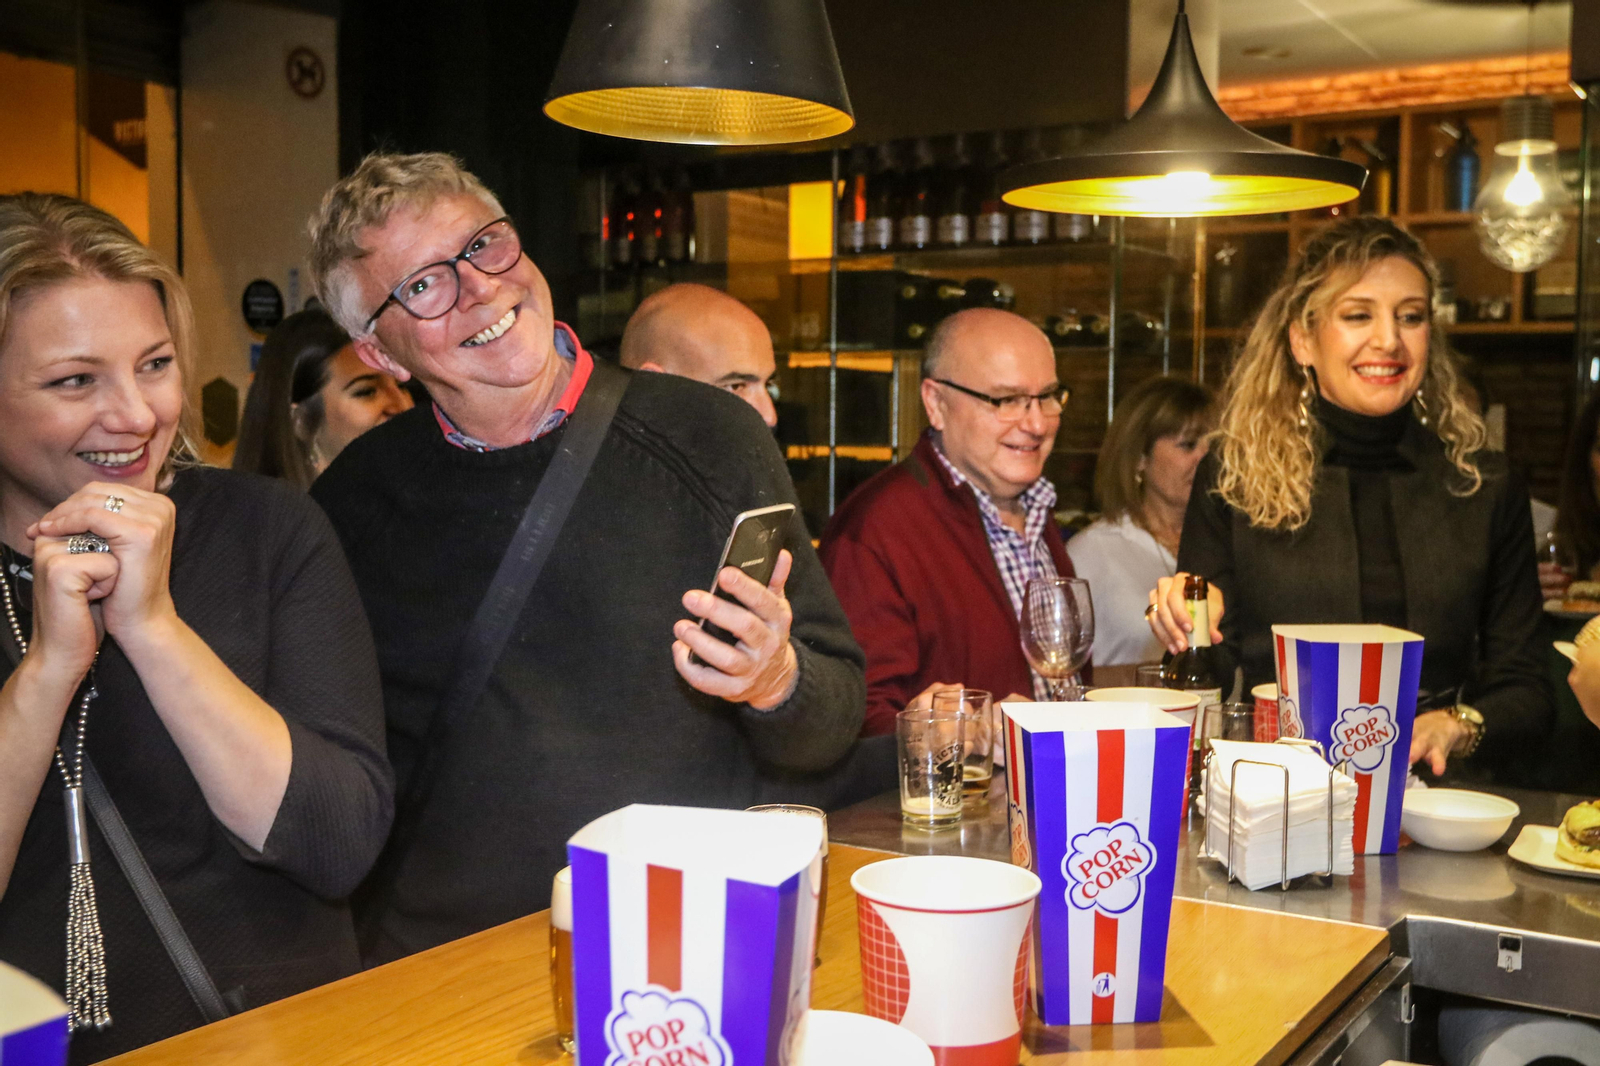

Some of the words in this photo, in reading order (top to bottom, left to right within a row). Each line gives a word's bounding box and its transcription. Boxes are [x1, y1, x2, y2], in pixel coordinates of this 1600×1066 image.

[1342, 726, 1389, 757] CORN
[1343, 717, 1378, 742] POP
[1078, 839, 1122, 879] POP
[1082, 848, 1142, 899] CORN
[627, 1018, 685, 1056] POP
